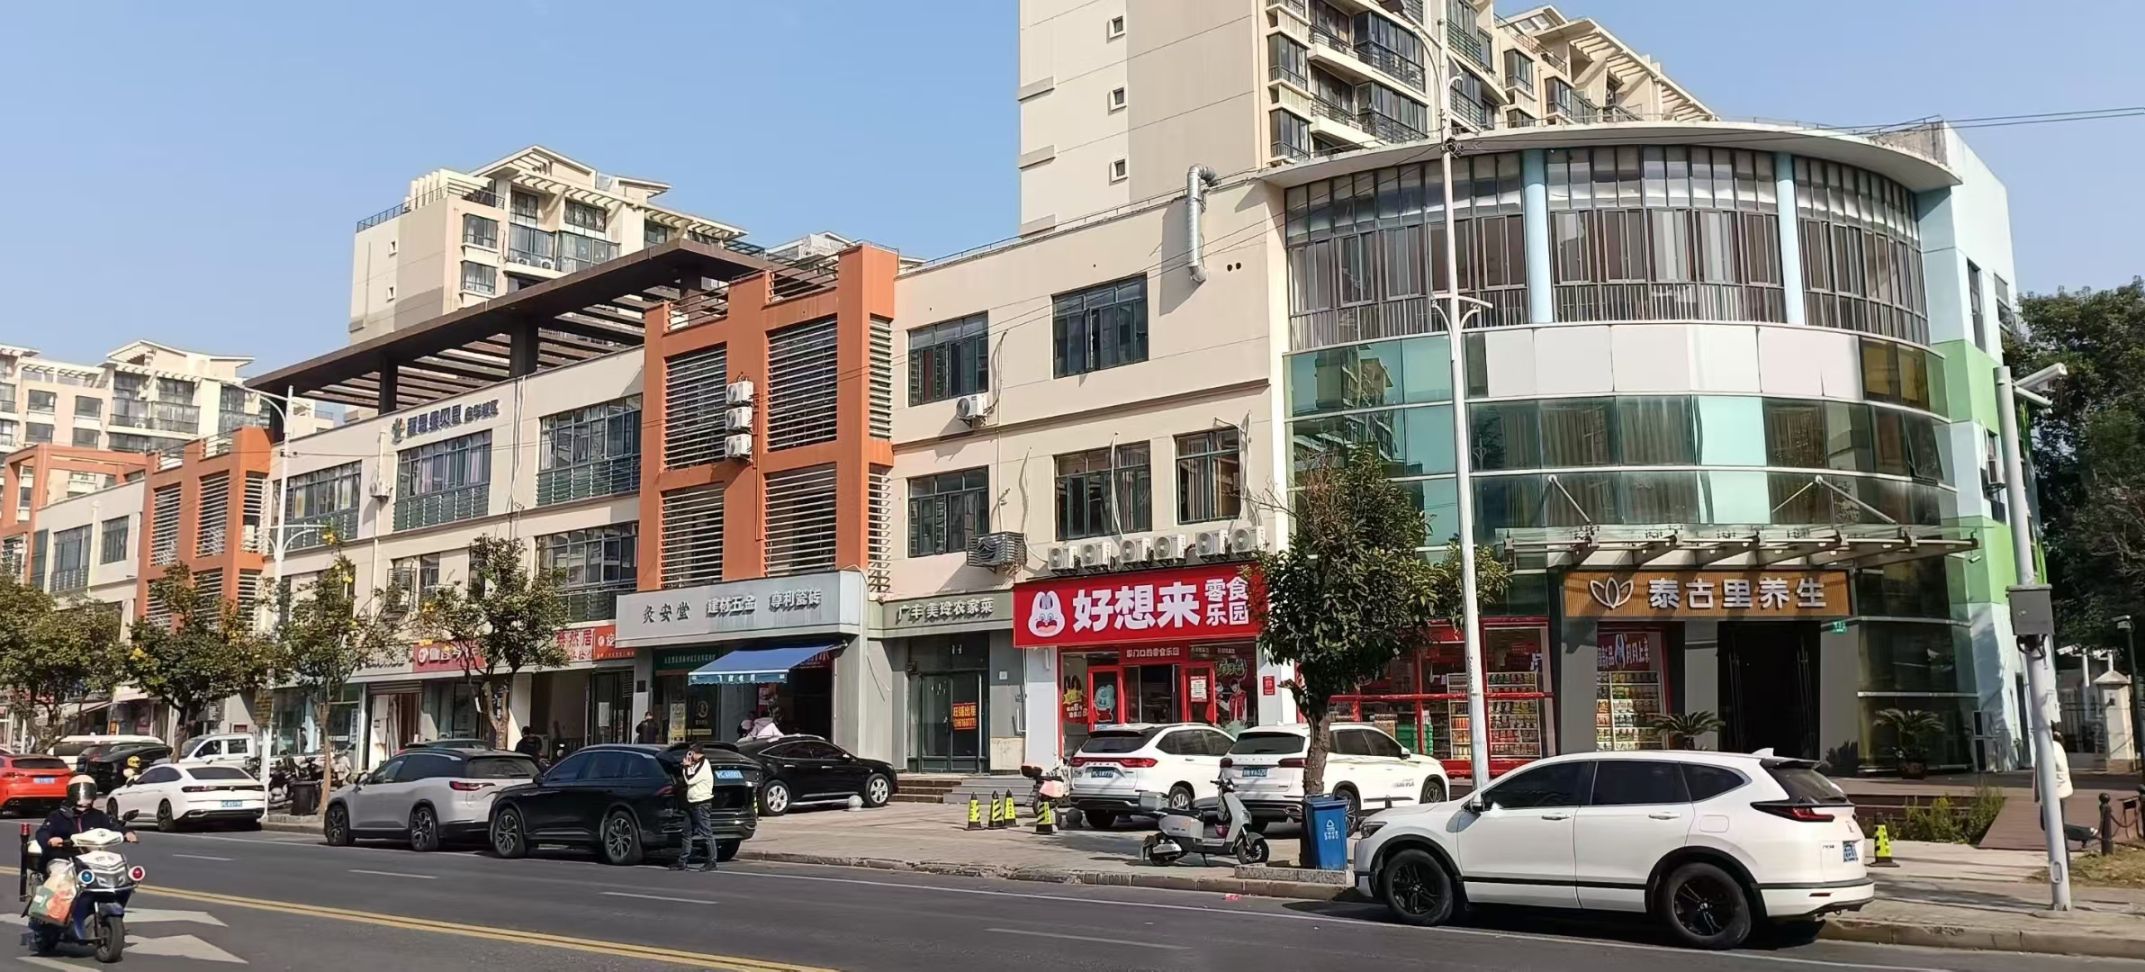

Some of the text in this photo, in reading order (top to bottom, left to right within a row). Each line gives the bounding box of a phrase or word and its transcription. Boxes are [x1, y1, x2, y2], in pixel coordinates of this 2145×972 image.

[1205, 576, 1249, 602] 零食
[1648, 577, 1827, 609] 泰古里养生
[706, 594, 756, 616] 建材五金
[1072, 581, 1201, 633] 好想来
[1206, 602, 1249, 627] 乐园
